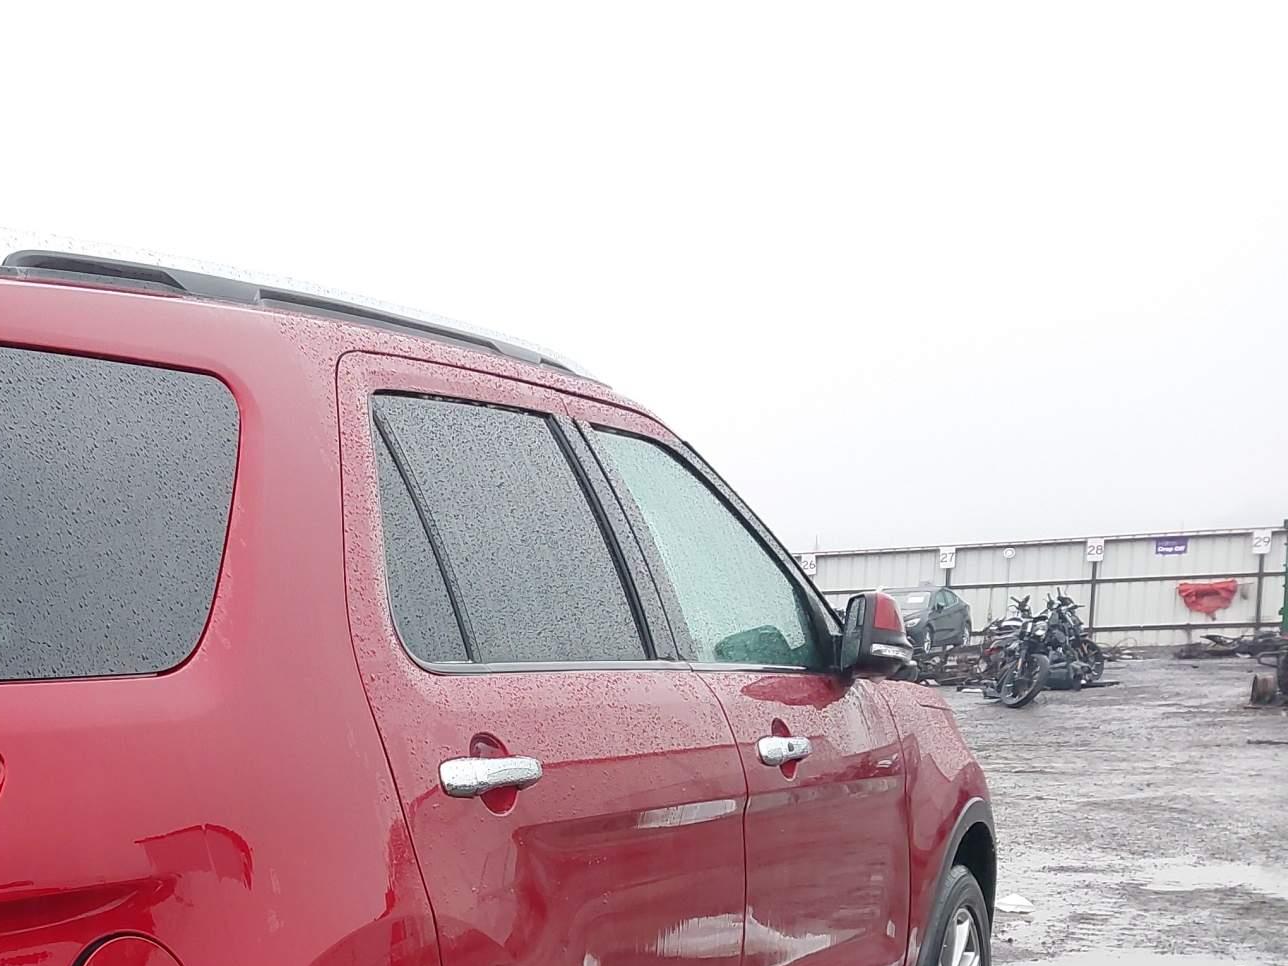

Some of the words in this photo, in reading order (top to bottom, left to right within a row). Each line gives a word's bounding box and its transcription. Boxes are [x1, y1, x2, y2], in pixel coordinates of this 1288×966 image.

[1254, 536, 1270, 548] 29
[1087, 544, 1104, 556] 28
[940, 552, 955, 563] 27
[801, 560, 816, 570] 26
